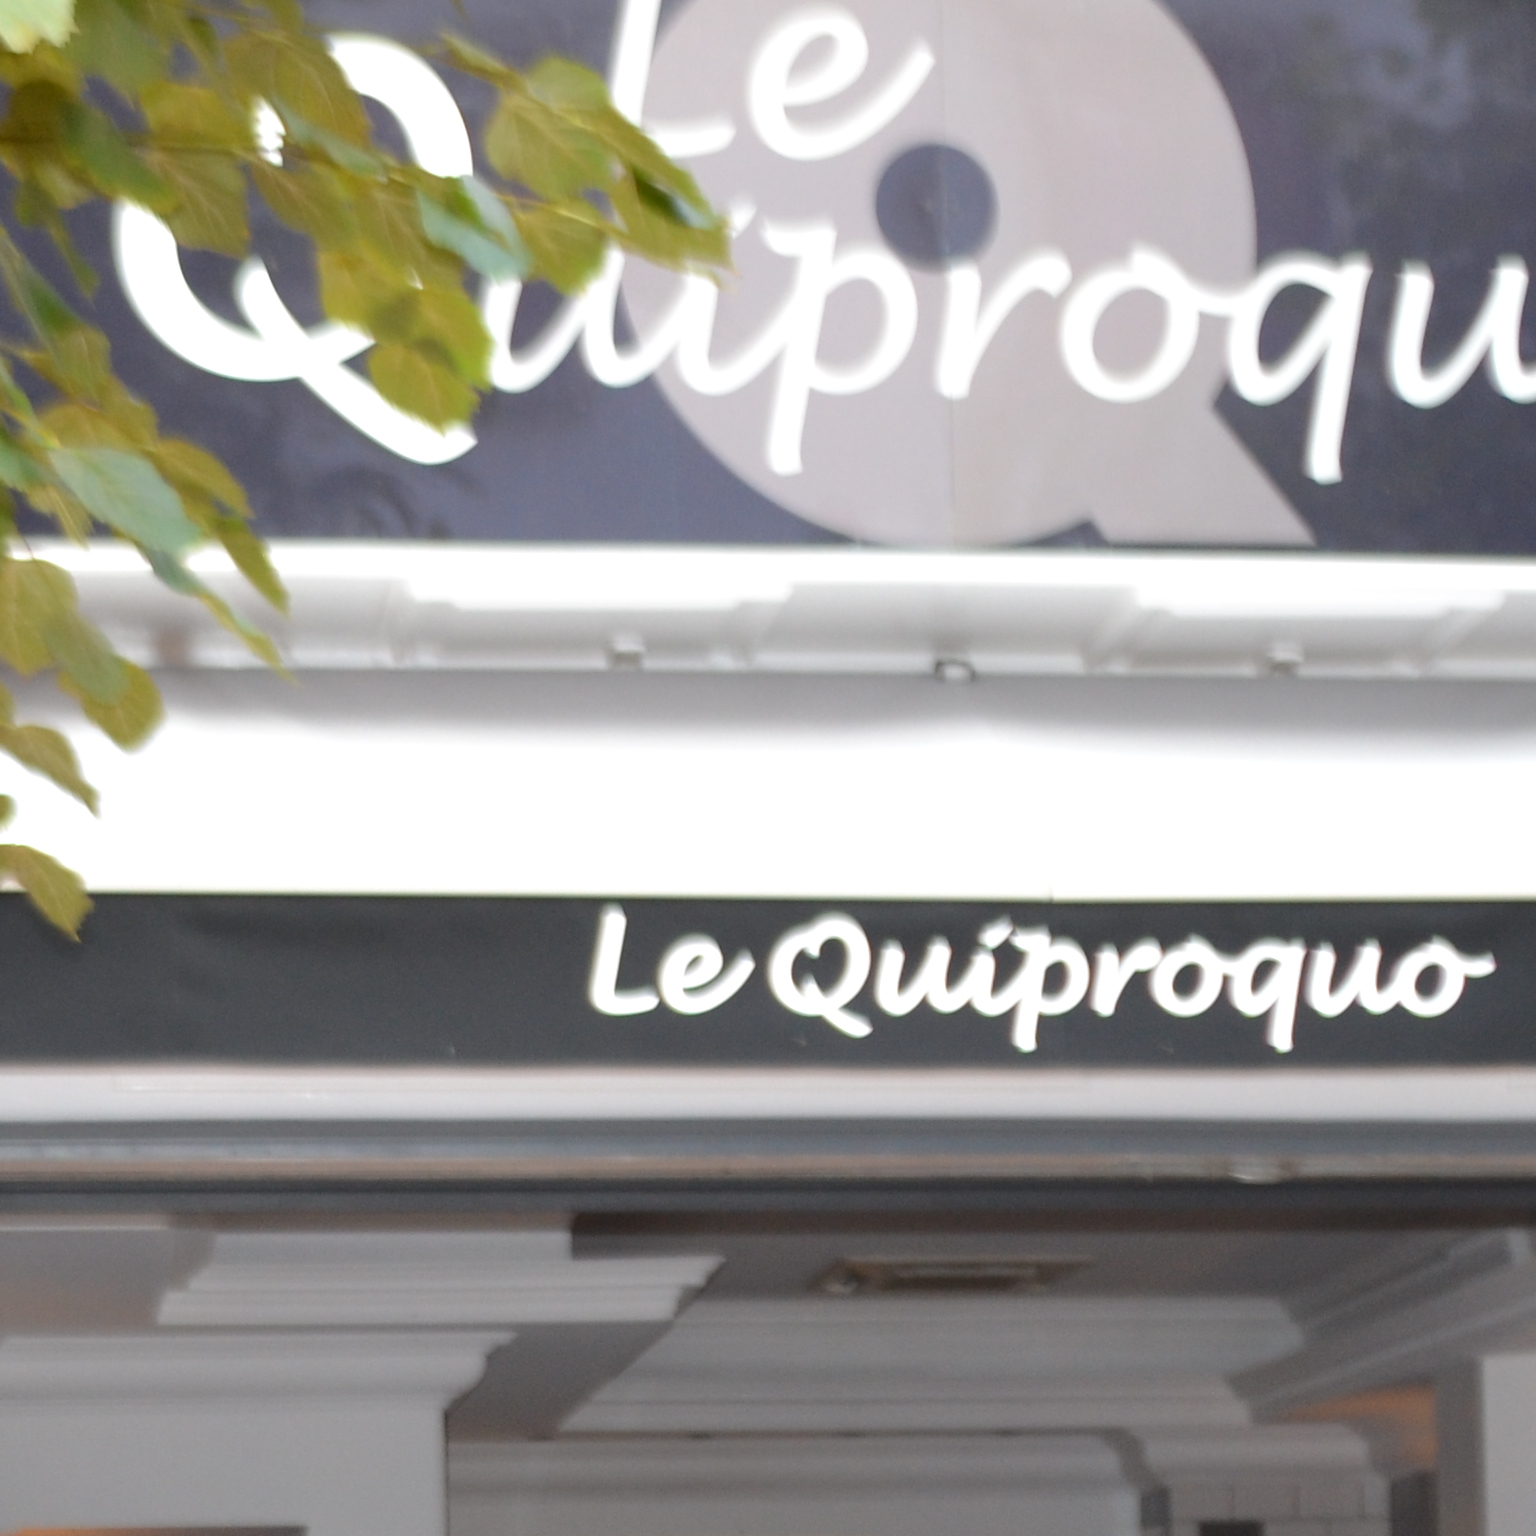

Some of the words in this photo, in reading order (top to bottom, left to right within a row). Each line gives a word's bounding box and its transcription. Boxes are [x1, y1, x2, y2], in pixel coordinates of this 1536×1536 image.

[608, 0, 936, 161] Le
[587, 902, 754, 1015] Le
[765, 912, 1496, 1053] Quiproquo
